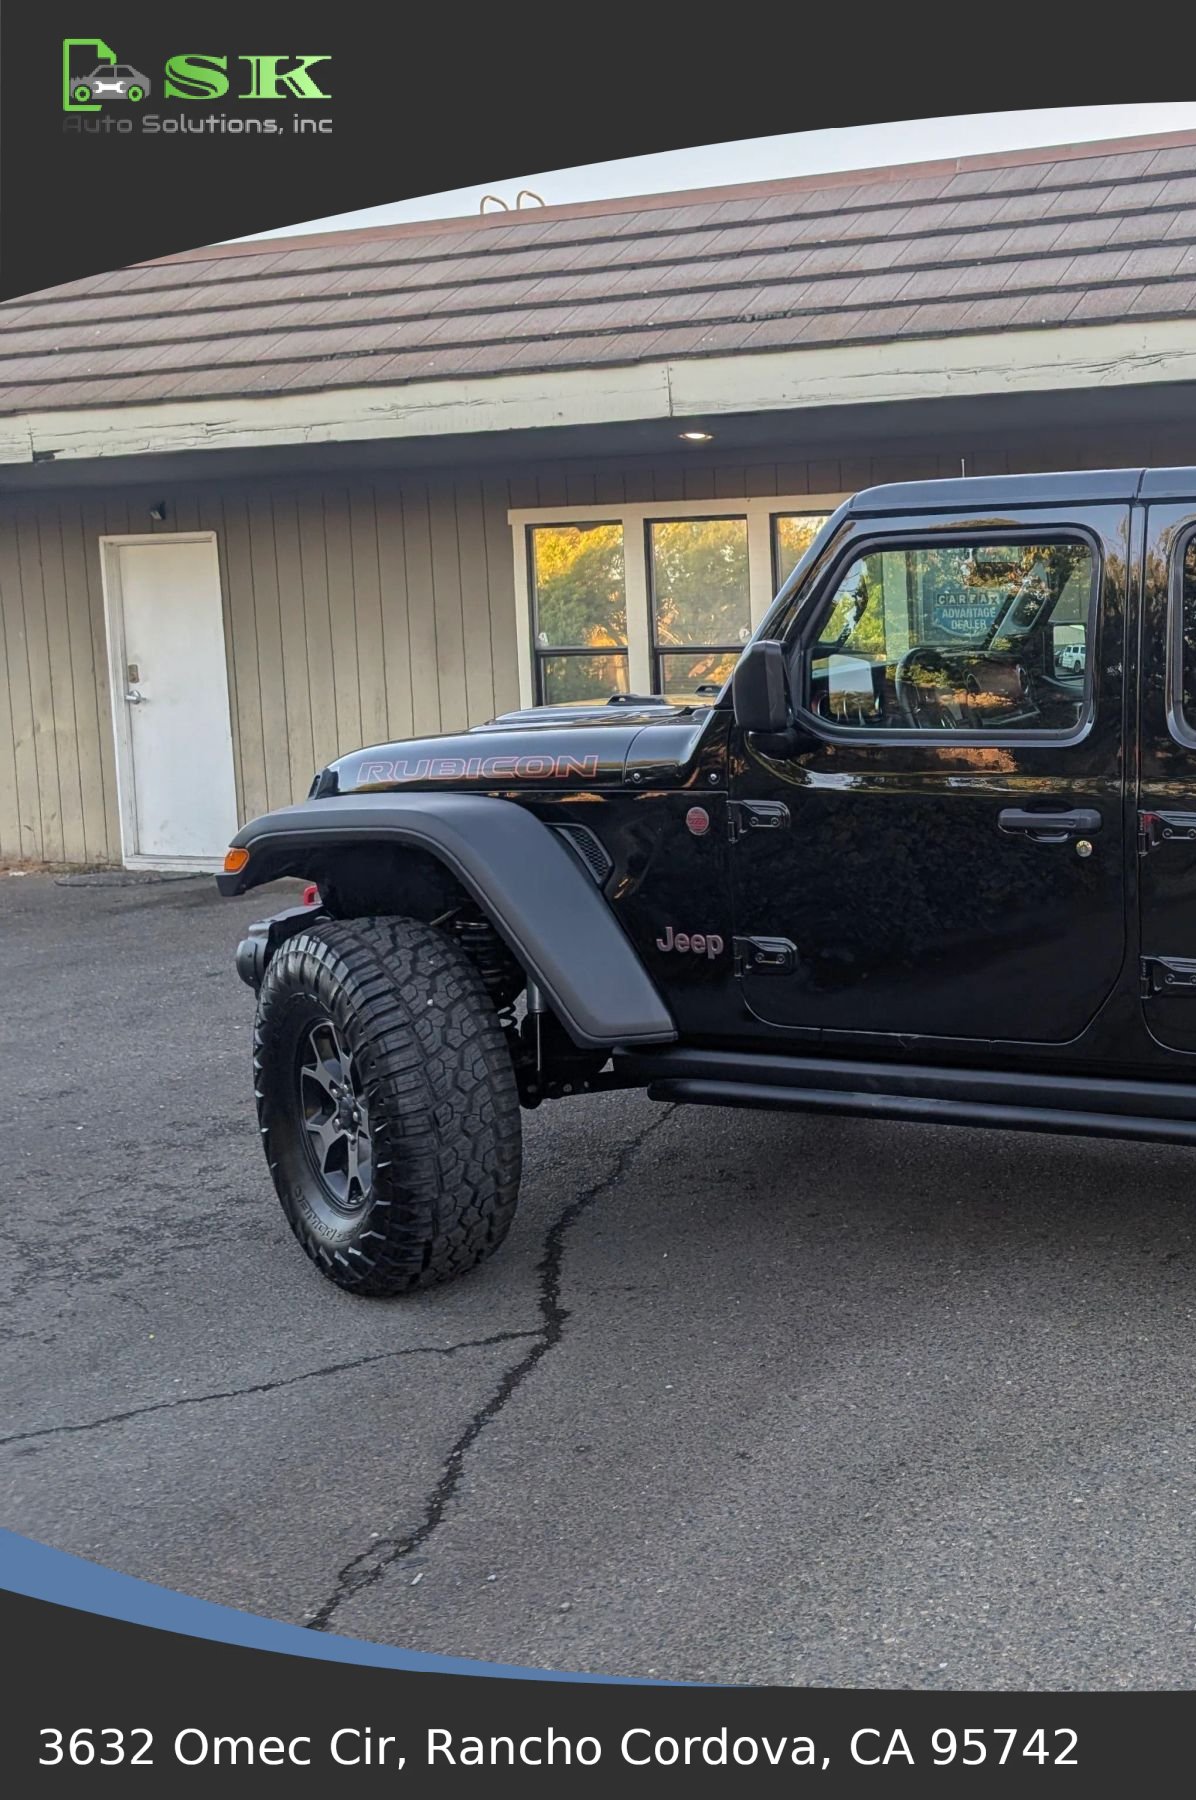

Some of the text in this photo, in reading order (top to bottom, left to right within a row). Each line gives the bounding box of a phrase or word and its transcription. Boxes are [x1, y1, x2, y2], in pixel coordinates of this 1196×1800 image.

[937, 593, 999, 605] CARFAX
[942, 606, 996, 618] ADVANTAGE
[951, 619, 987, 630] DEALER
[356, 754, 600, 784] RUBICON
[656, 926, 725, 960] Jeep
